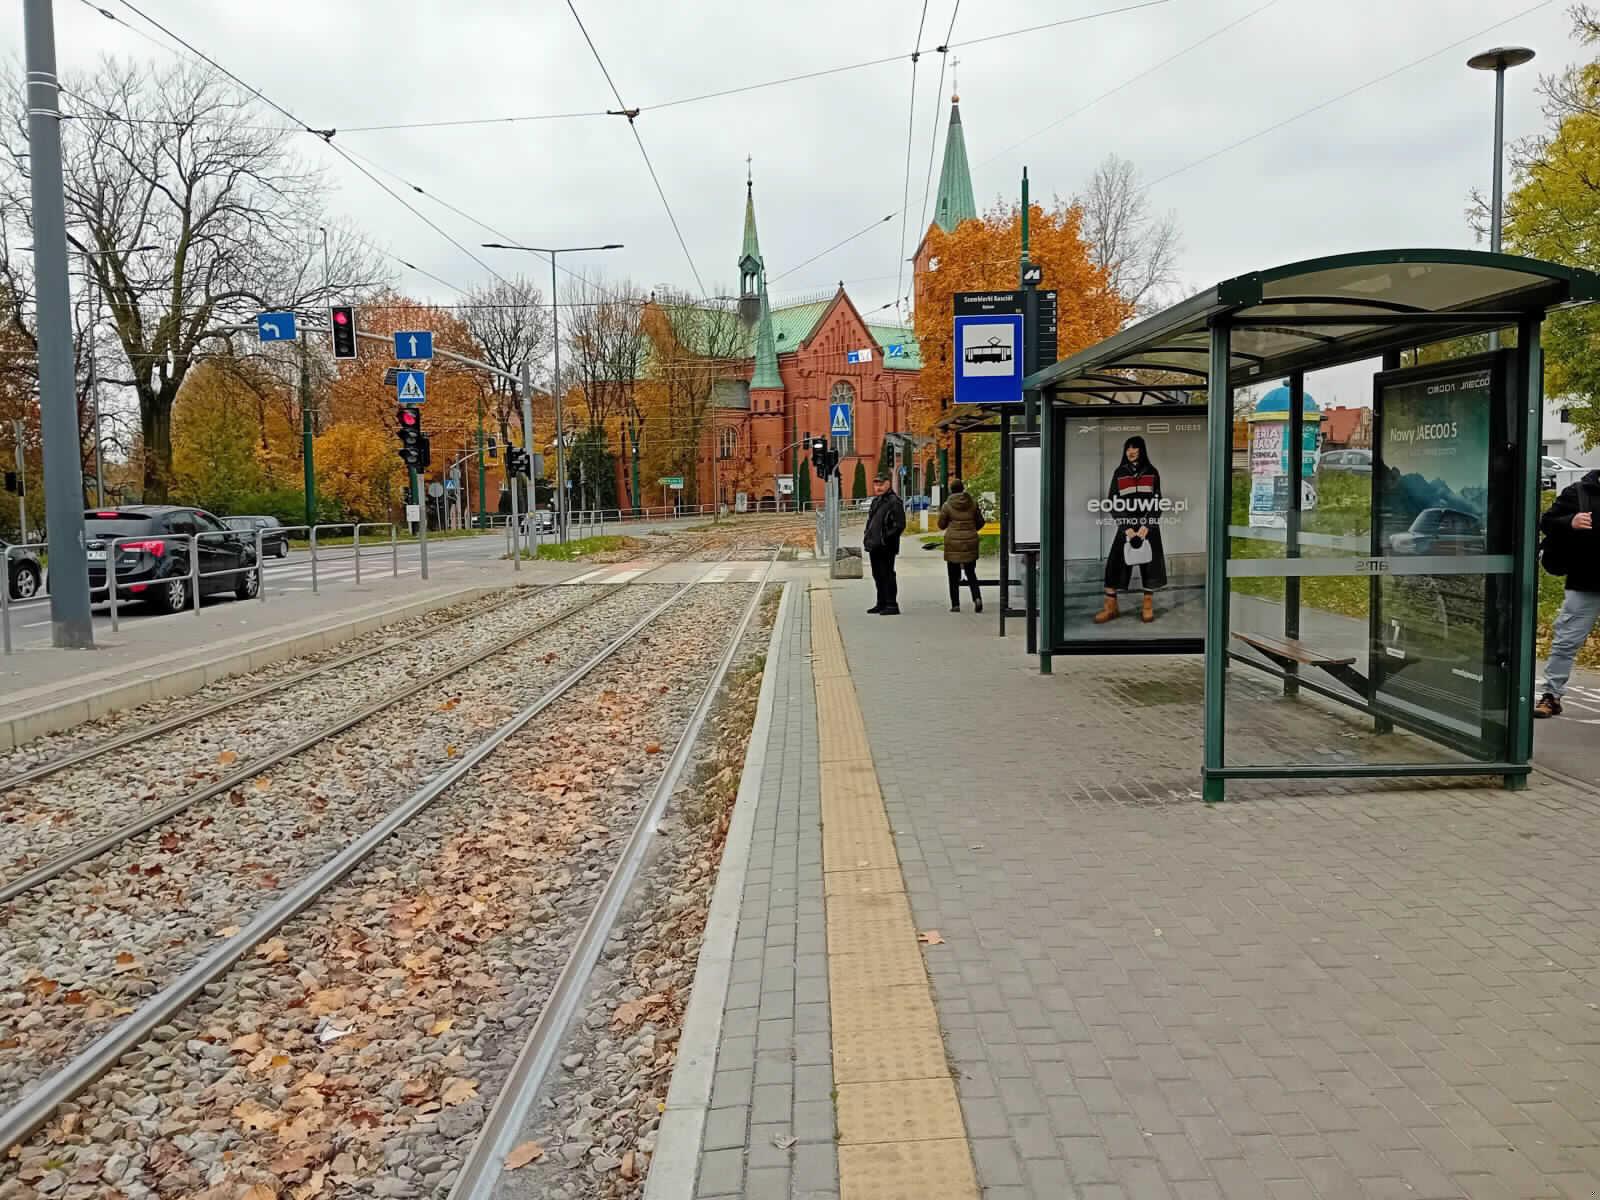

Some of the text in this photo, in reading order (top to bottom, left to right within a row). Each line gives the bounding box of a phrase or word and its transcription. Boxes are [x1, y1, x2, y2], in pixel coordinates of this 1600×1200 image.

[1390, 422, 1457, 444] Nowy JAECOO 5
[1087, 494, 1189, 514] eobuwie.pl
